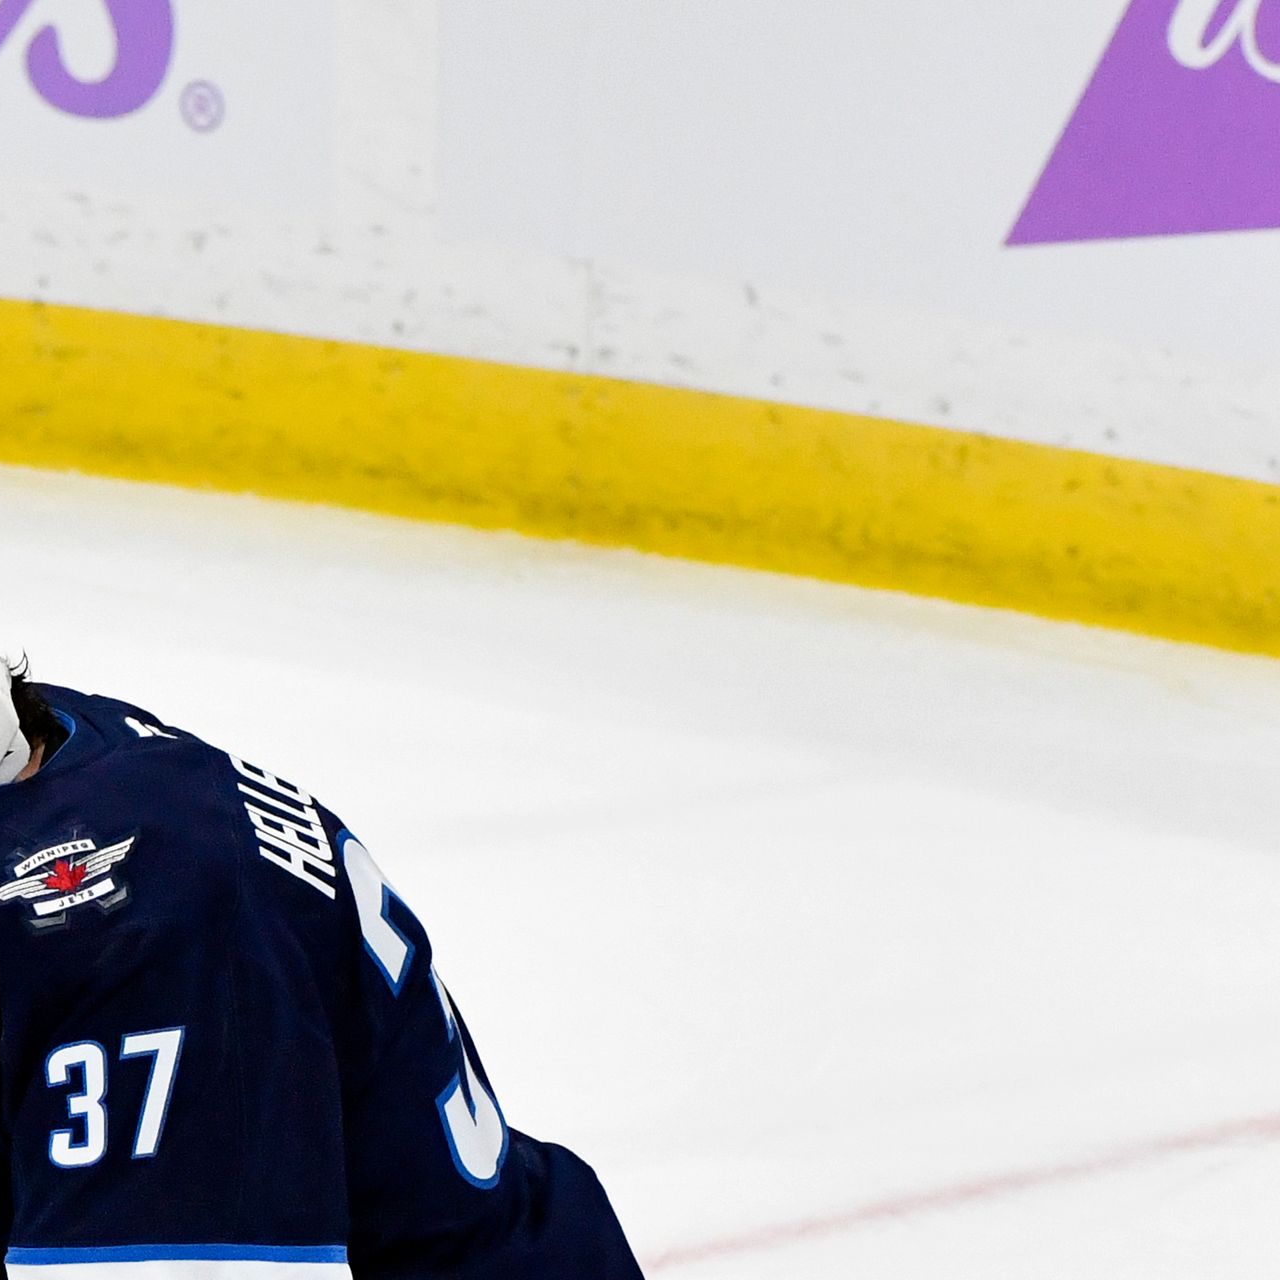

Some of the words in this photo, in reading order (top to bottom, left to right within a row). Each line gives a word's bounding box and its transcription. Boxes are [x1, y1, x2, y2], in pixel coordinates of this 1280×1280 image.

[21, 842, 89, 871] WINNIPEG
[58, 890, 95, 907] JETS
[45, 1025, 186, 1169] 37
